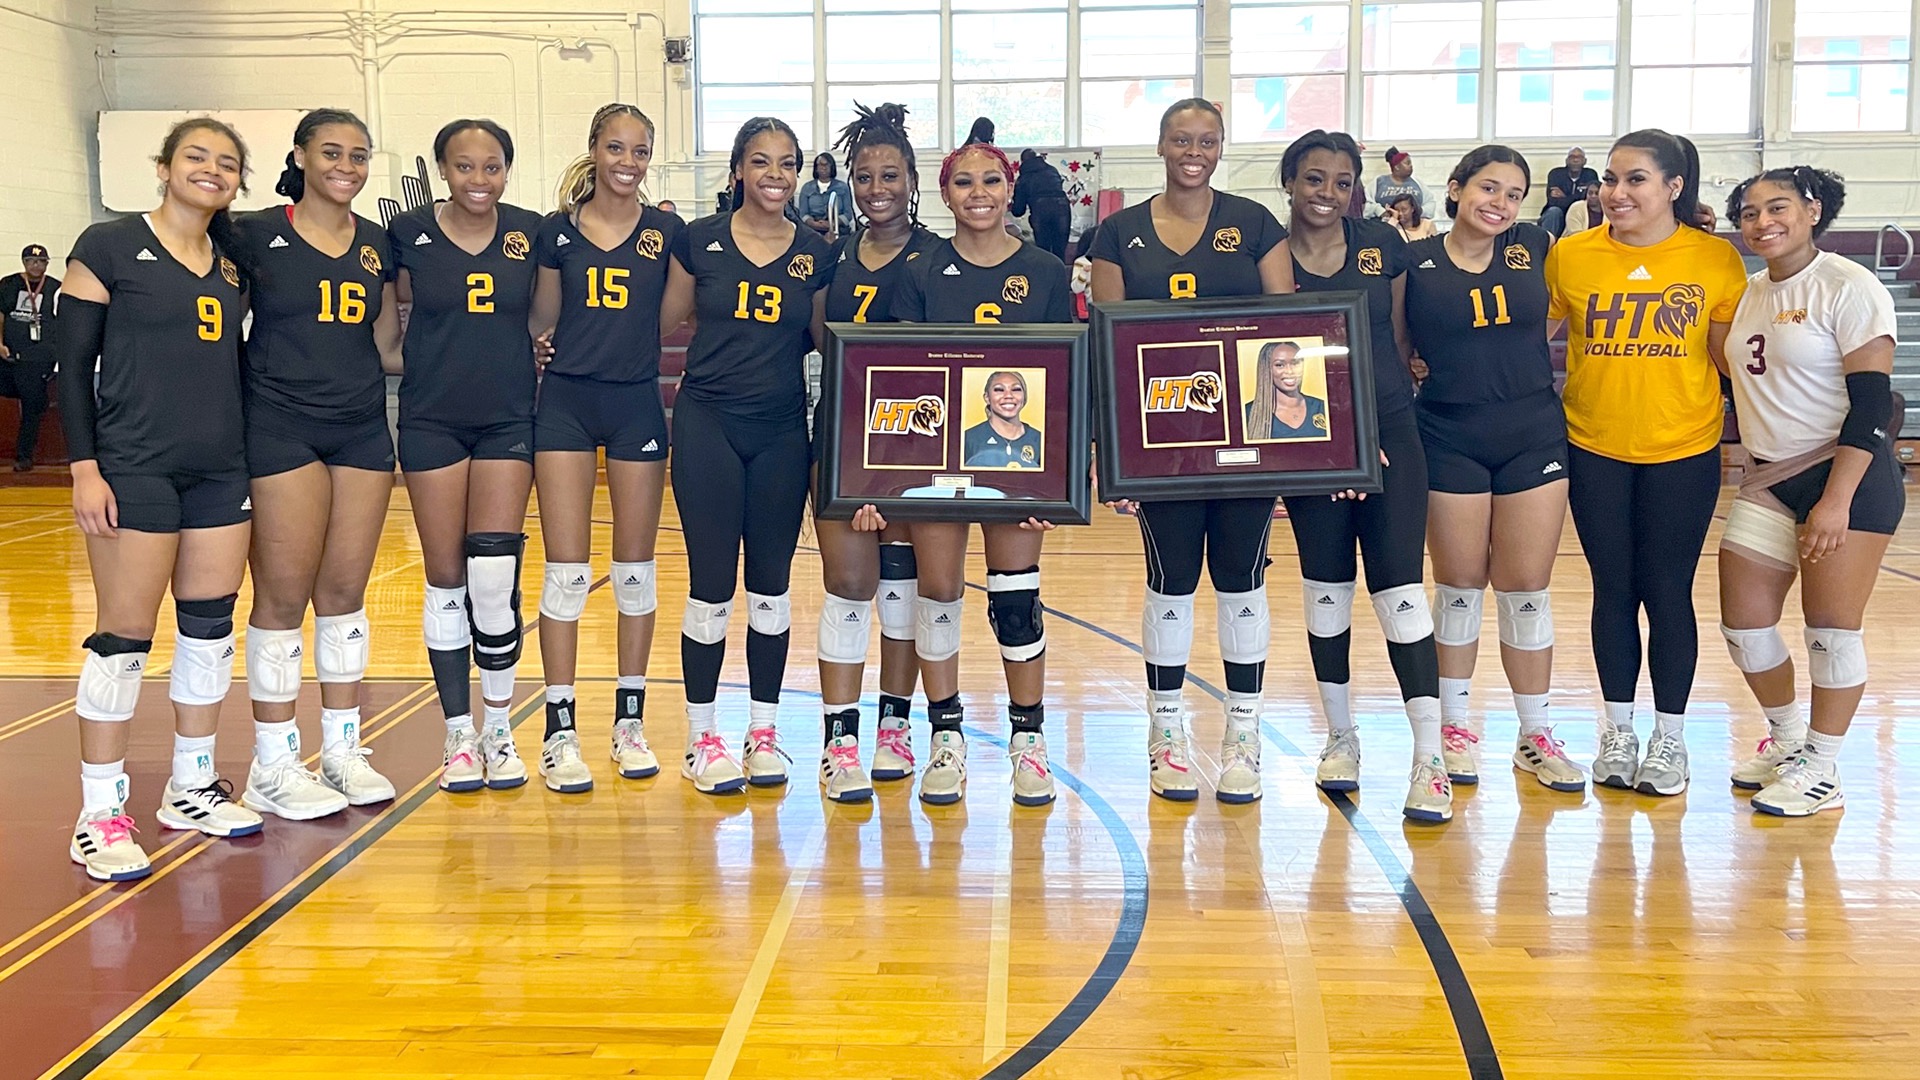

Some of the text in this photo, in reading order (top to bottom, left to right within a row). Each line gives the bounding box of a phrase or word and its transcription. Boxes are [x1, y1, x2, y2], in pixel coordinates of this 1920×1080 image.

[318, 280, 366, 324] 16
[467, 273, 494, 313] 2
[586, 267, 630, 309] 15
[734, 281, 782, 323] 13
[853, 285, 878, 324] 7
[1469, 285, 1511, 327] 11
[197, 296, 223, 341] 9
[1585, 292, 1663, 339] HT
[1585, 343, 1687, 357] VOLLEYBALL
[1746, 334, 1767, 375] 3
[1148, 380, 1193, 409] HT
[872, 402, 917, 431] HT
